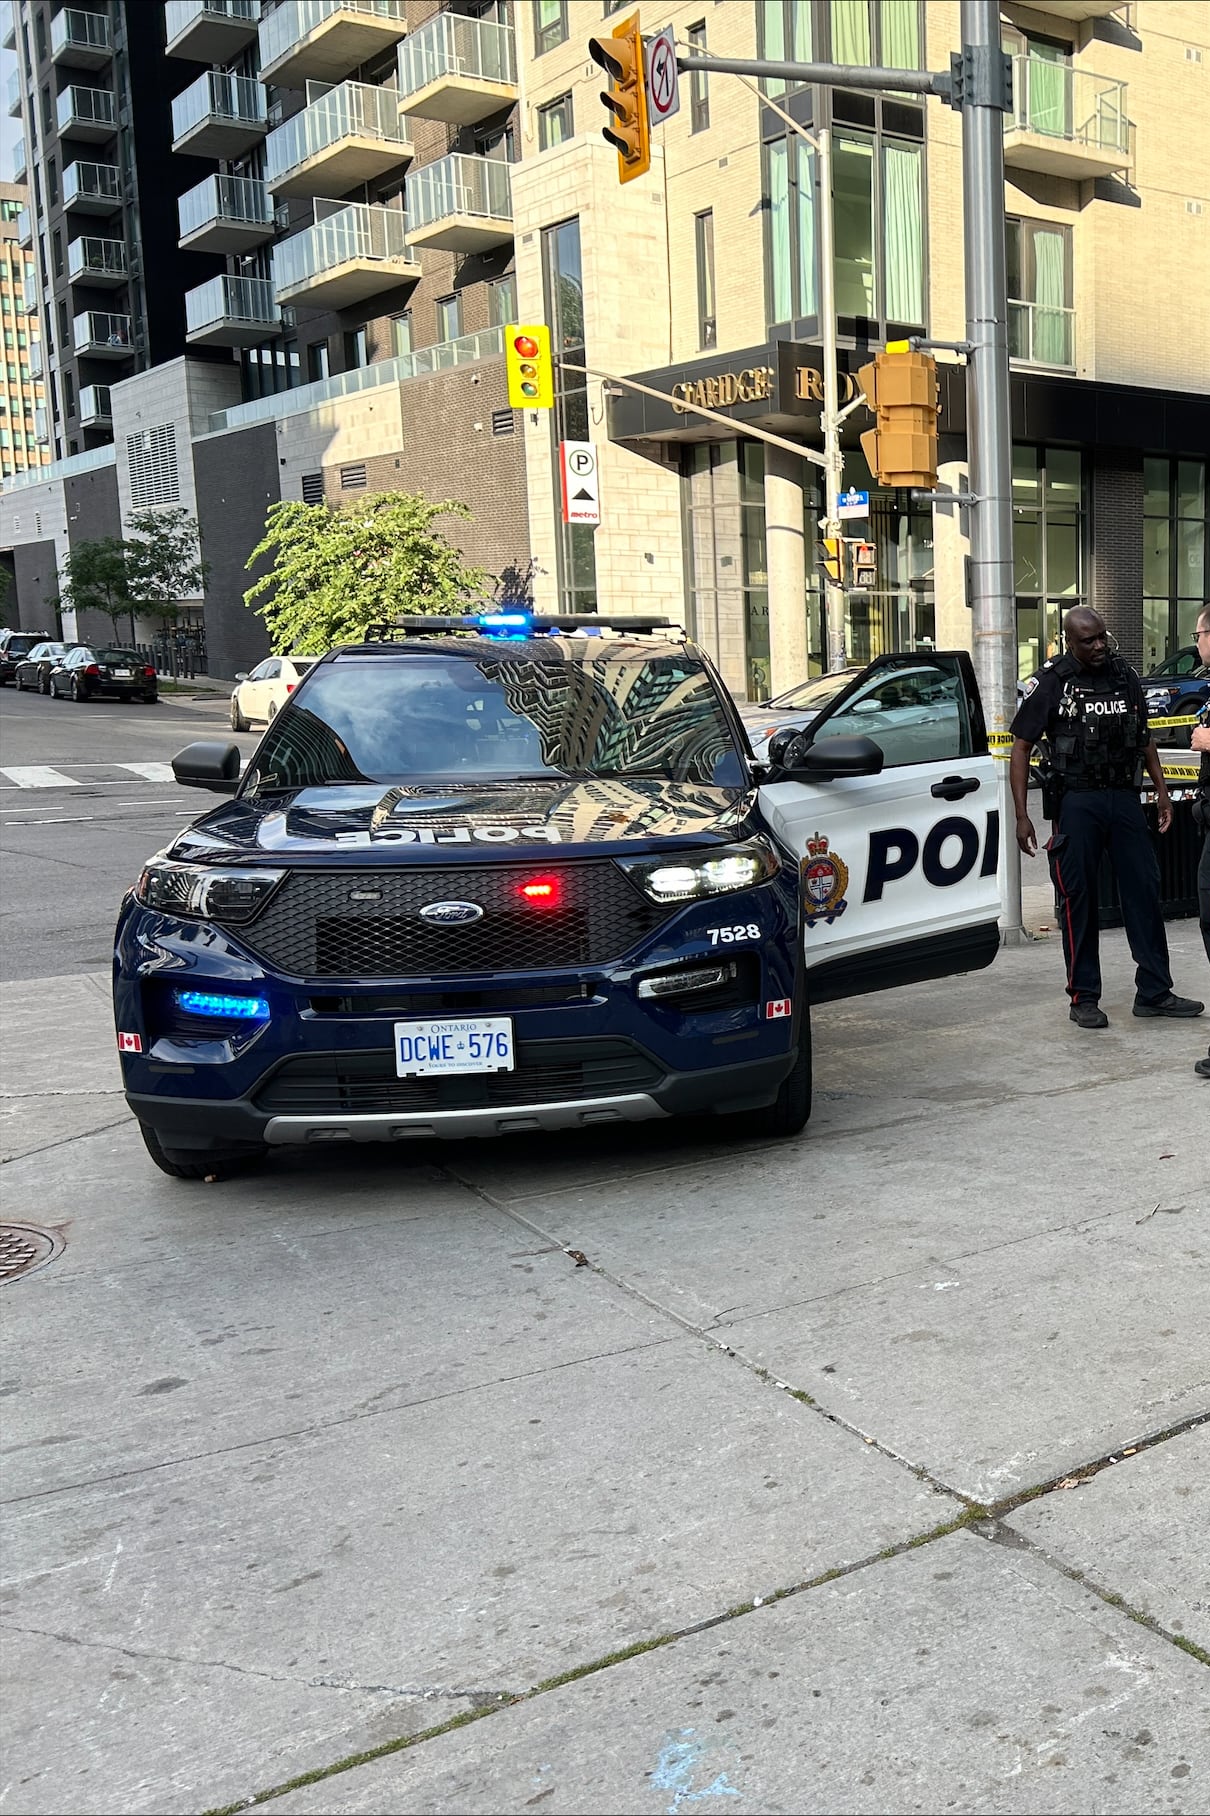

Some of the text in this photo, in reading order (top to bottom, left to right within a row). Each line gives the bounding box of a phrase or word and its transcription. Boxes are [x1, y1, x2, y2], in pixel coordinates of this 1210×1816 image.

[576, 454, 589, 471] P
[570, 511, 598, 519] metro
[1085, 700, 1128, 716] POLICE
[435, 905, 468, 921] Ford
[706, 923, 762, 946] 7528
[430, 1023, 478, 1034] ONTARIO
[400, 1032, 509, 1063] DCWE 576
